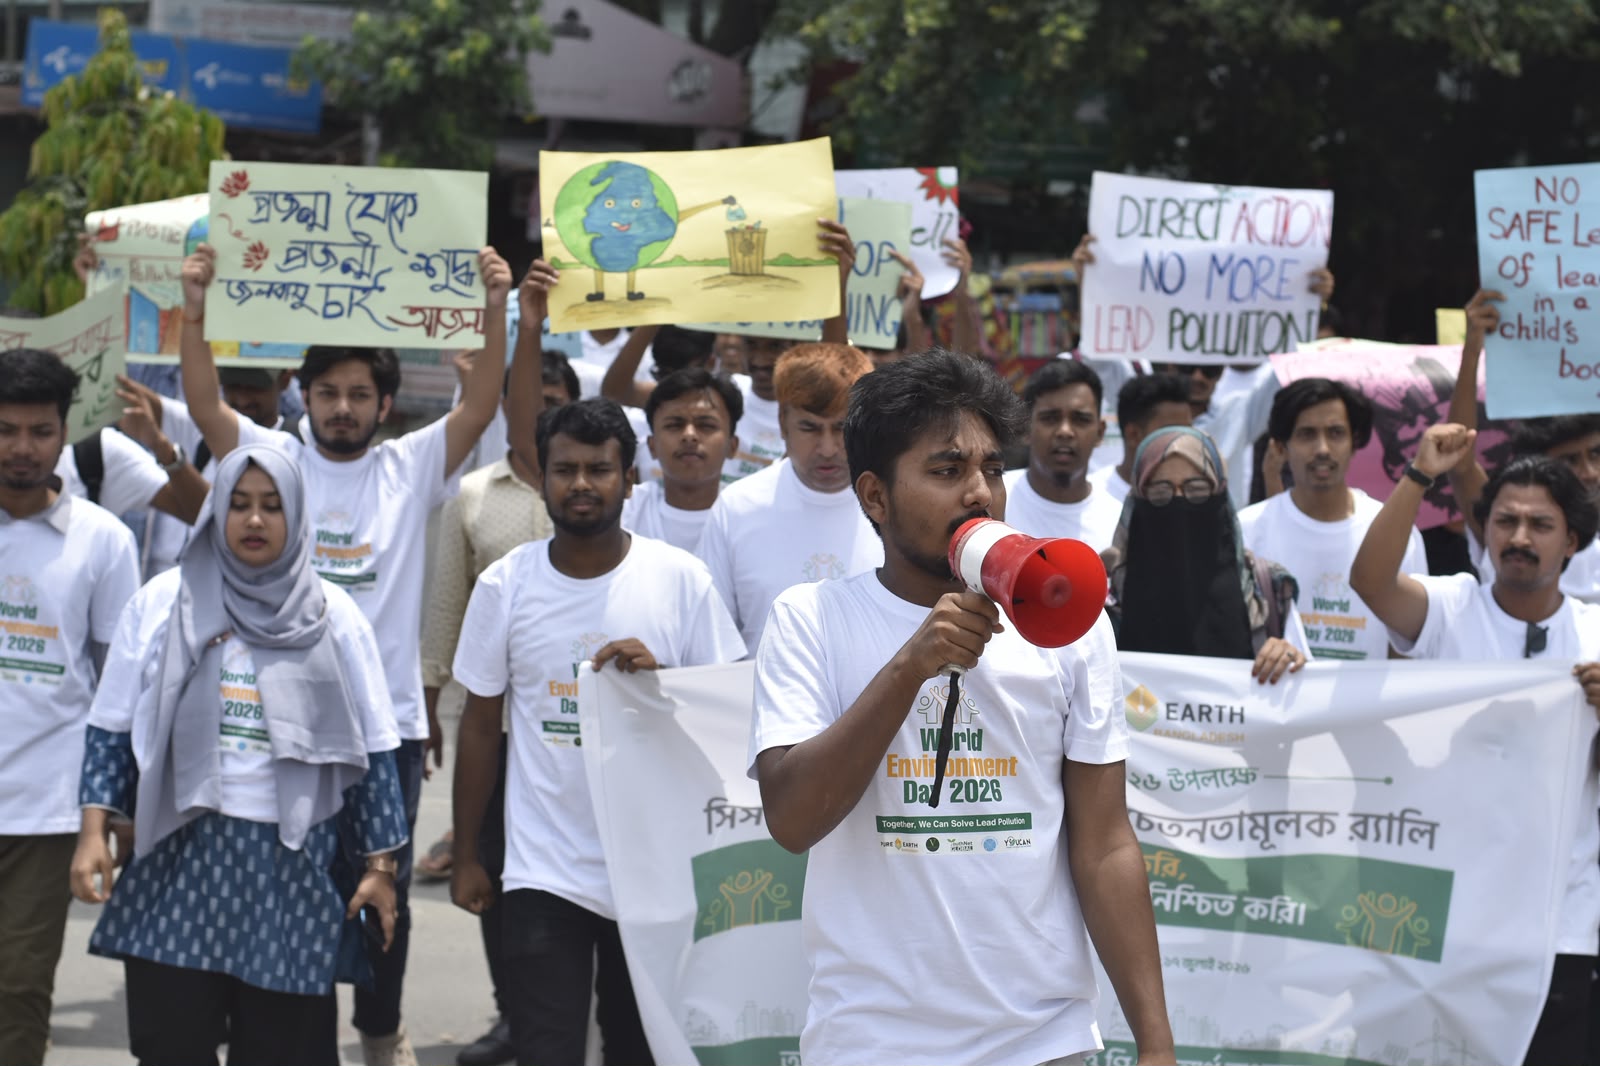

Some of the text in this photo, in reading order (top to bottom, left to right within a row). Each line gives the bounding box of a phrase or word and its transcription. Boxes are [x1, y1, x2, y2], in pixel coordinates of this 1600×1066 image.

[1534, 176, 1580, 205] NO
[248, 190, 331, 232] প্রজন্ম
[1116, 195, 1333, 248] DIRECT ACTION
[1488, 206, 1600, 248] SAFE Le
[1139, 250, 1301, 303] NO MORE
[1556, 255, 1600, 290] lea
[1533, 293, 1591, 314] in a
[1093, 303, 1155, 354] LEAD
[224, 700, 264, 720] 2026
[560, 698, 578, 714] Da
[1165, 702, 1245, 724] EARTH
[903, 778, 1002, 804] Da 2026
[703, 796, 763, 835] সিস
[882, 817, 1025, 829] Together, We Can Solve Lead Pollution
